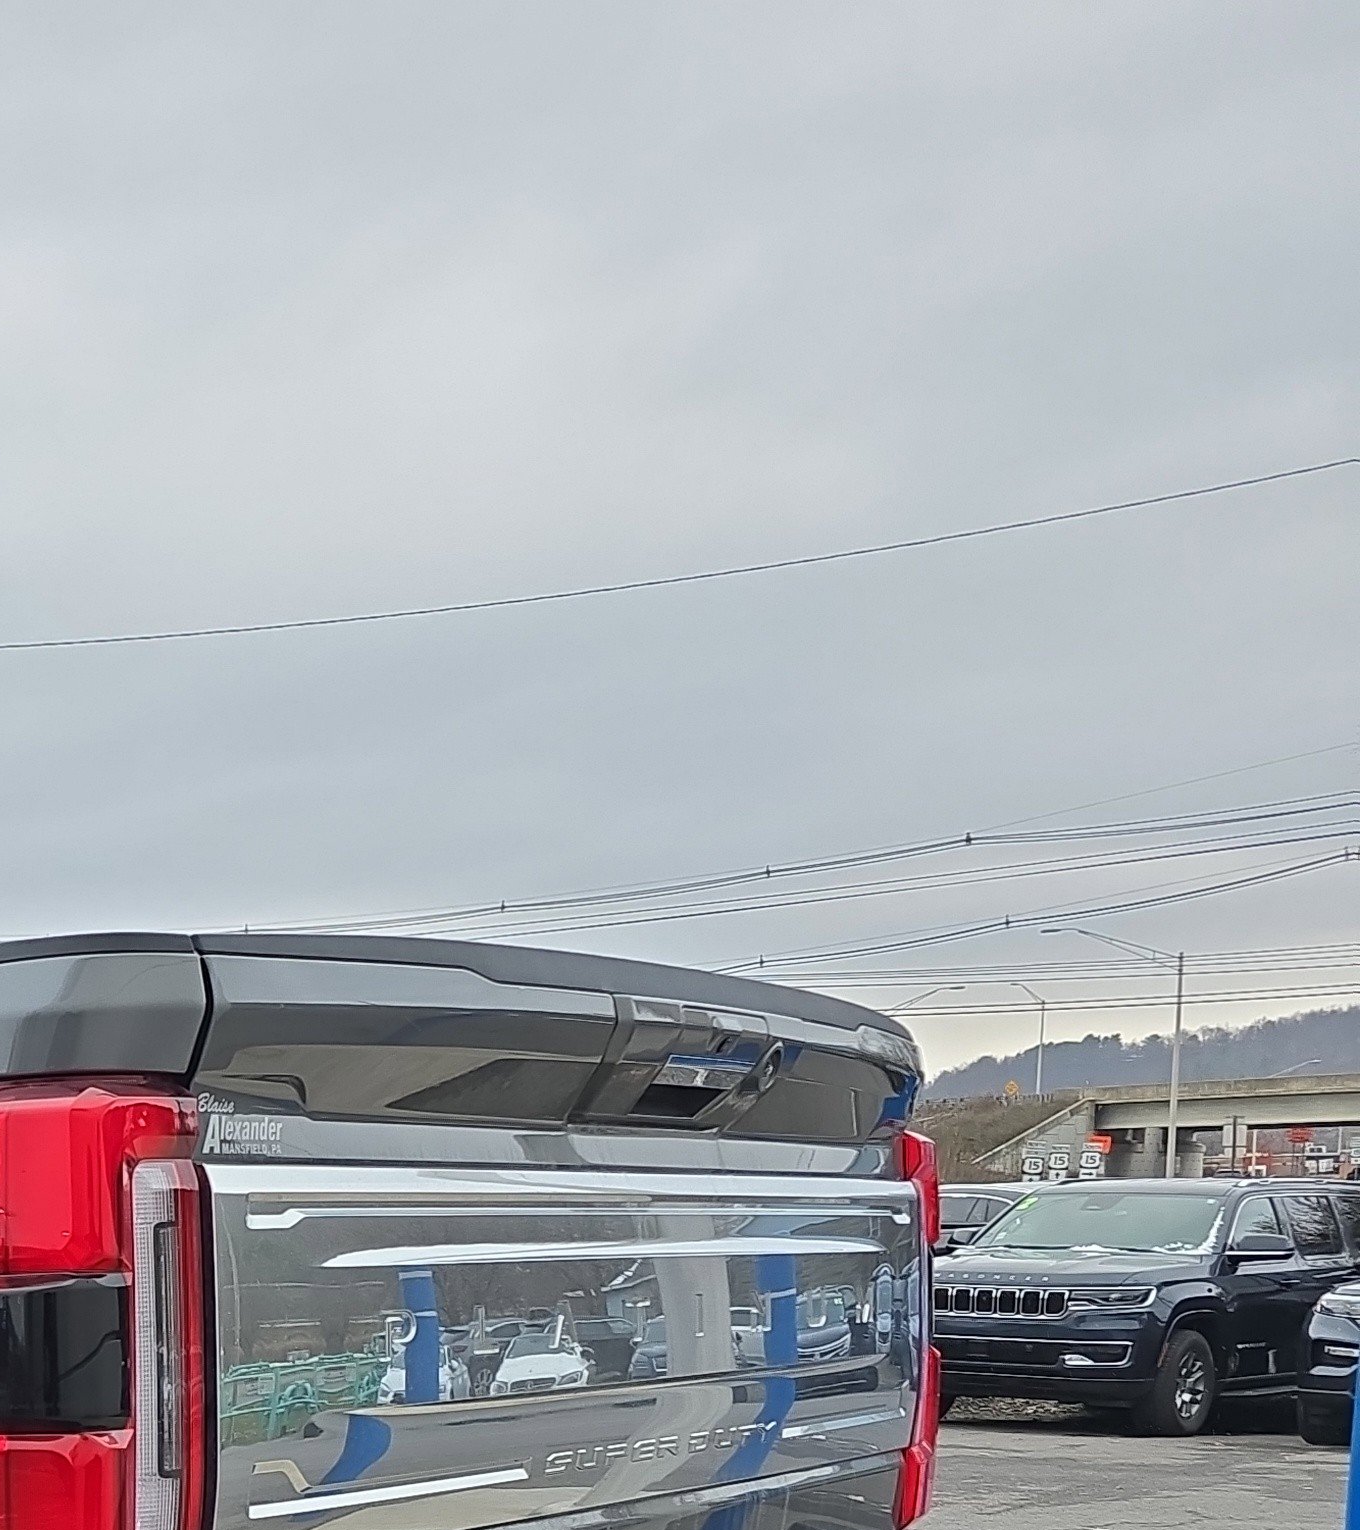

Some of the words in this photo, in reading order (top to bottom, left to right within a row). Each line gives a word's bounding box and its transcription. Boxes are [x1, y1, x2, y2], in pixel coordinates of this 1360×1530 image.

[197, 1092, 235, 1113] Blaise
[202, 1113, 282, 1154] Alexander
[271, 1144, 282, 1154] PA
[1028, 1160, 1040, 1171] 15
[1054, 1156, 1066, 1166] 15
[1085, 1155, 1097, 1165] 15
[544, 1435, 679, 1476] SUPER
[688, 1420, 777, 1454] DUTY
